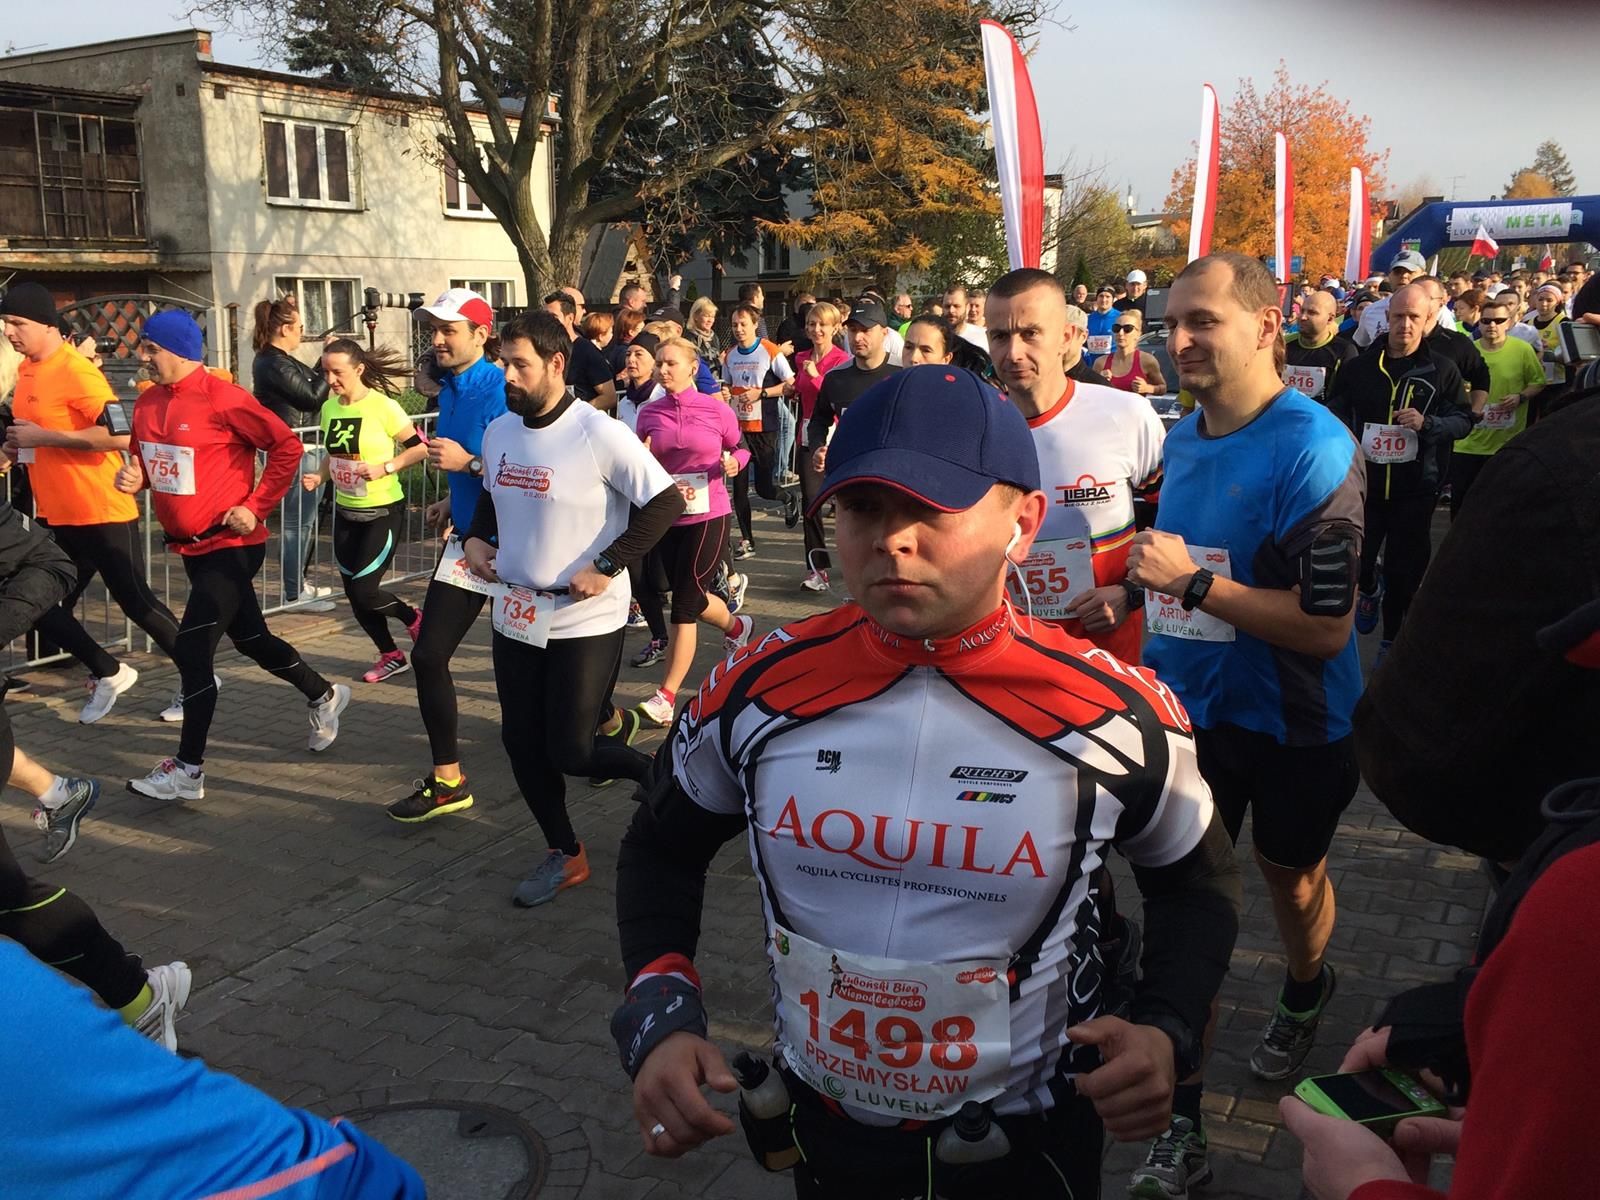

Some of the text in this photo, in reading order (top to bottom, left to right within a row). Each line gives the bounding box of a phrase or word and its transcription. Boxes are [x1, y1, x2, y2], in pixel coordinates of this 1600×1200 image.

[1505, 213, 1564, 228] META
[1453, 227, 1495, 236] LUVEA
[1288, 376, 1314, 388] 816
[736, 403, 753, 412] 149
[1371, 437, 1406, 451] 310
[149, 460, 179, 478] 754
[1064, 486, 1110, 503] LIBRA
[451, 569, 488, 585] KRZYSZTO
[1006, 567, 1069, 595] 155
[1020, 595, 1060, 606] MACIEJ
[503, 595, 536, 625] 734
[1159, 607, 1192, 622] ARTUR
[1166, 625, 1204, 637] LUVENA
[817, 749, 842, 767] BCM
[956, 767, 1024, 780] RITCHEY
[989, 792, 1017, 804] WCS
[768, 795, 1049, 879] AQUILA
[795, 863, 1007, 903] AQUILA CYCLISTES PROFESSIONNELS
[842, 974, 920, 995] Luboński Bieg
[800, 989, 978, 1071] 1498
[805, 1040, 970, 1094] PRZEMYSŁAW
[855, 1088, 945, 1115] LUVENA
